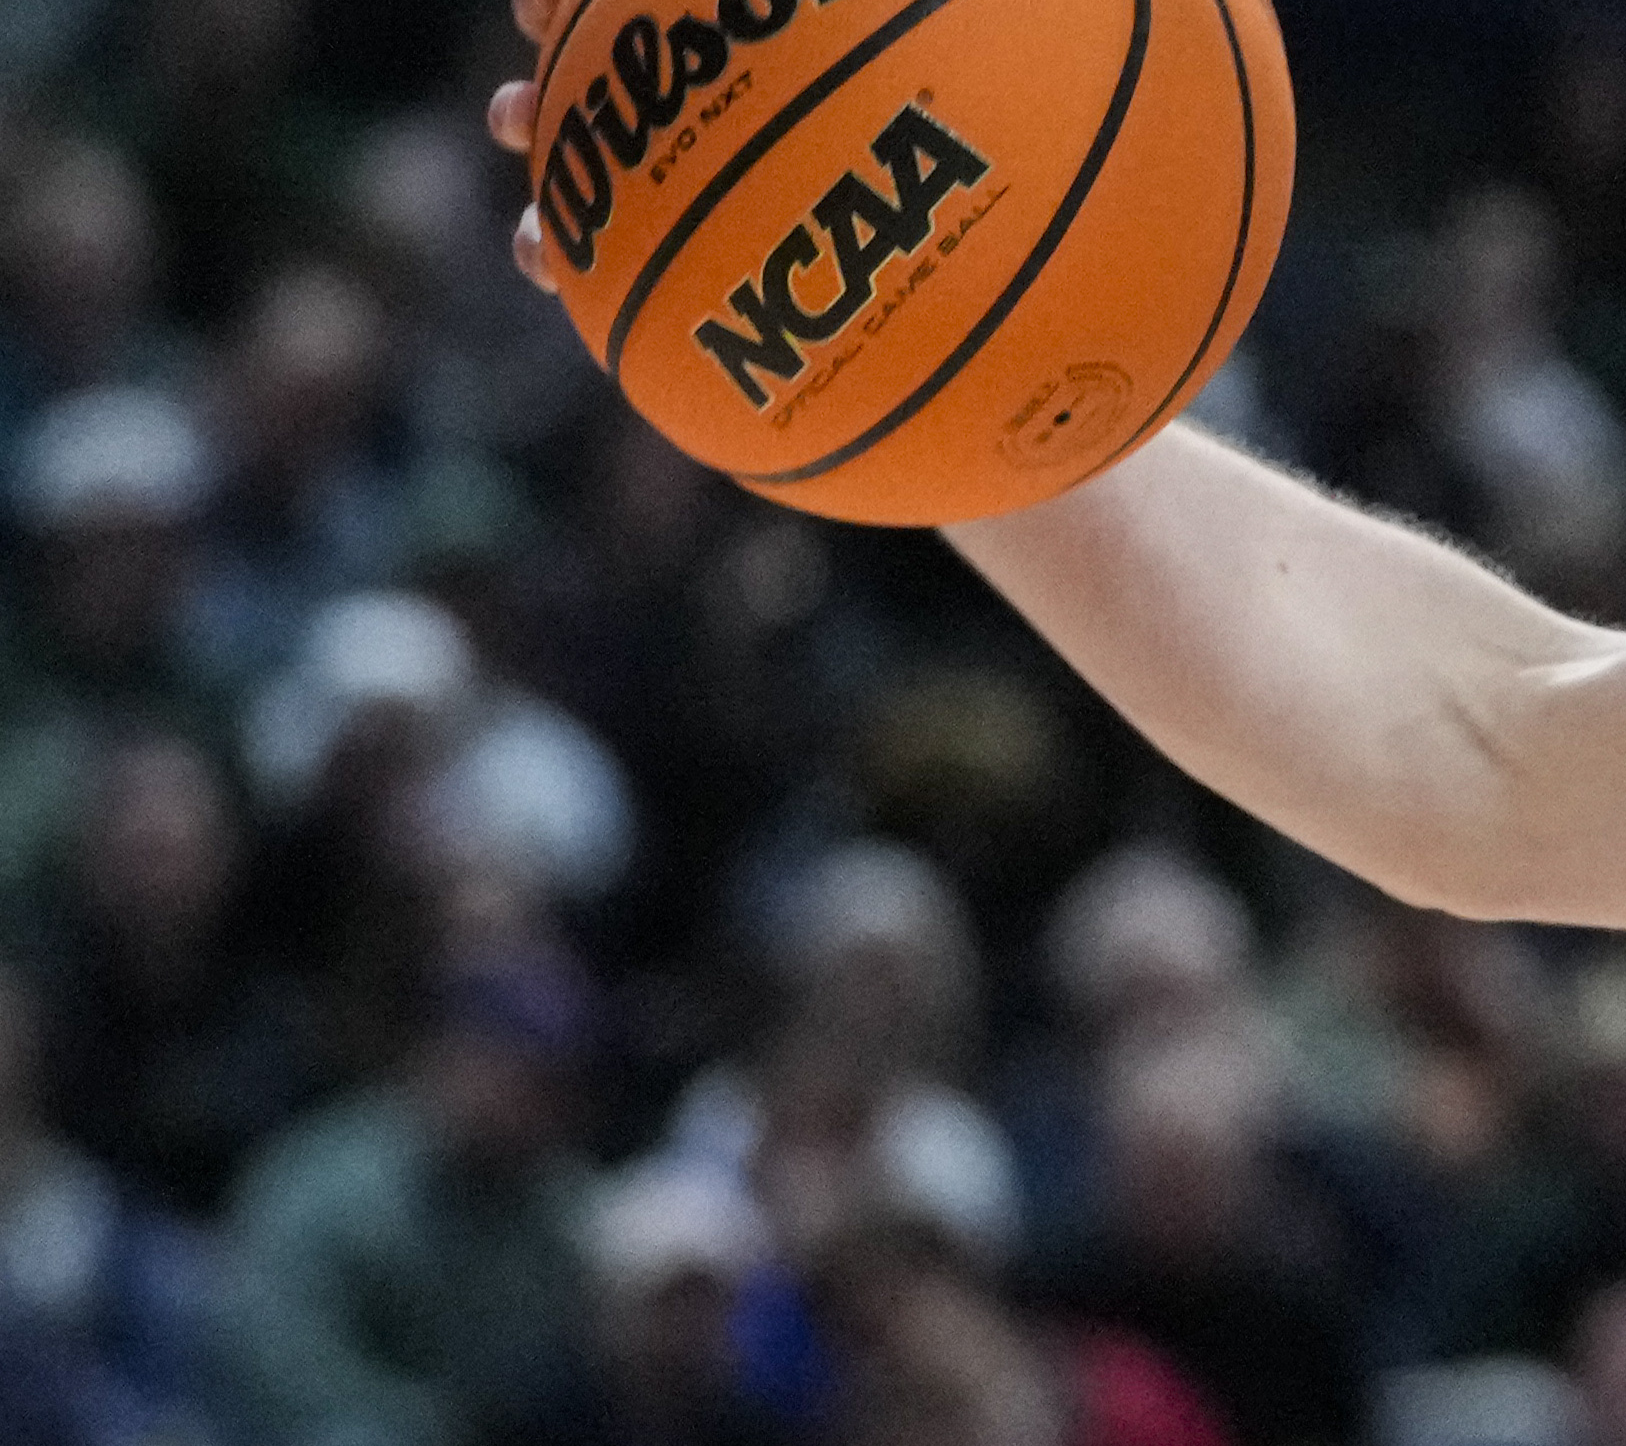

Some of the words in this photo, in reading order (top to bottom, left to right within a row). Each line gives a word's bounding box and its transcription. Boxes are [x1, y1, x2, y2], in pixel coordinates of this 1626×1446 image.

[650, 127, 698, 185] EVO
[700, 69, 755, 125] NXT
[691, 101, 992, 413] NCAA
[936, 184, 1012, 257] BALL
